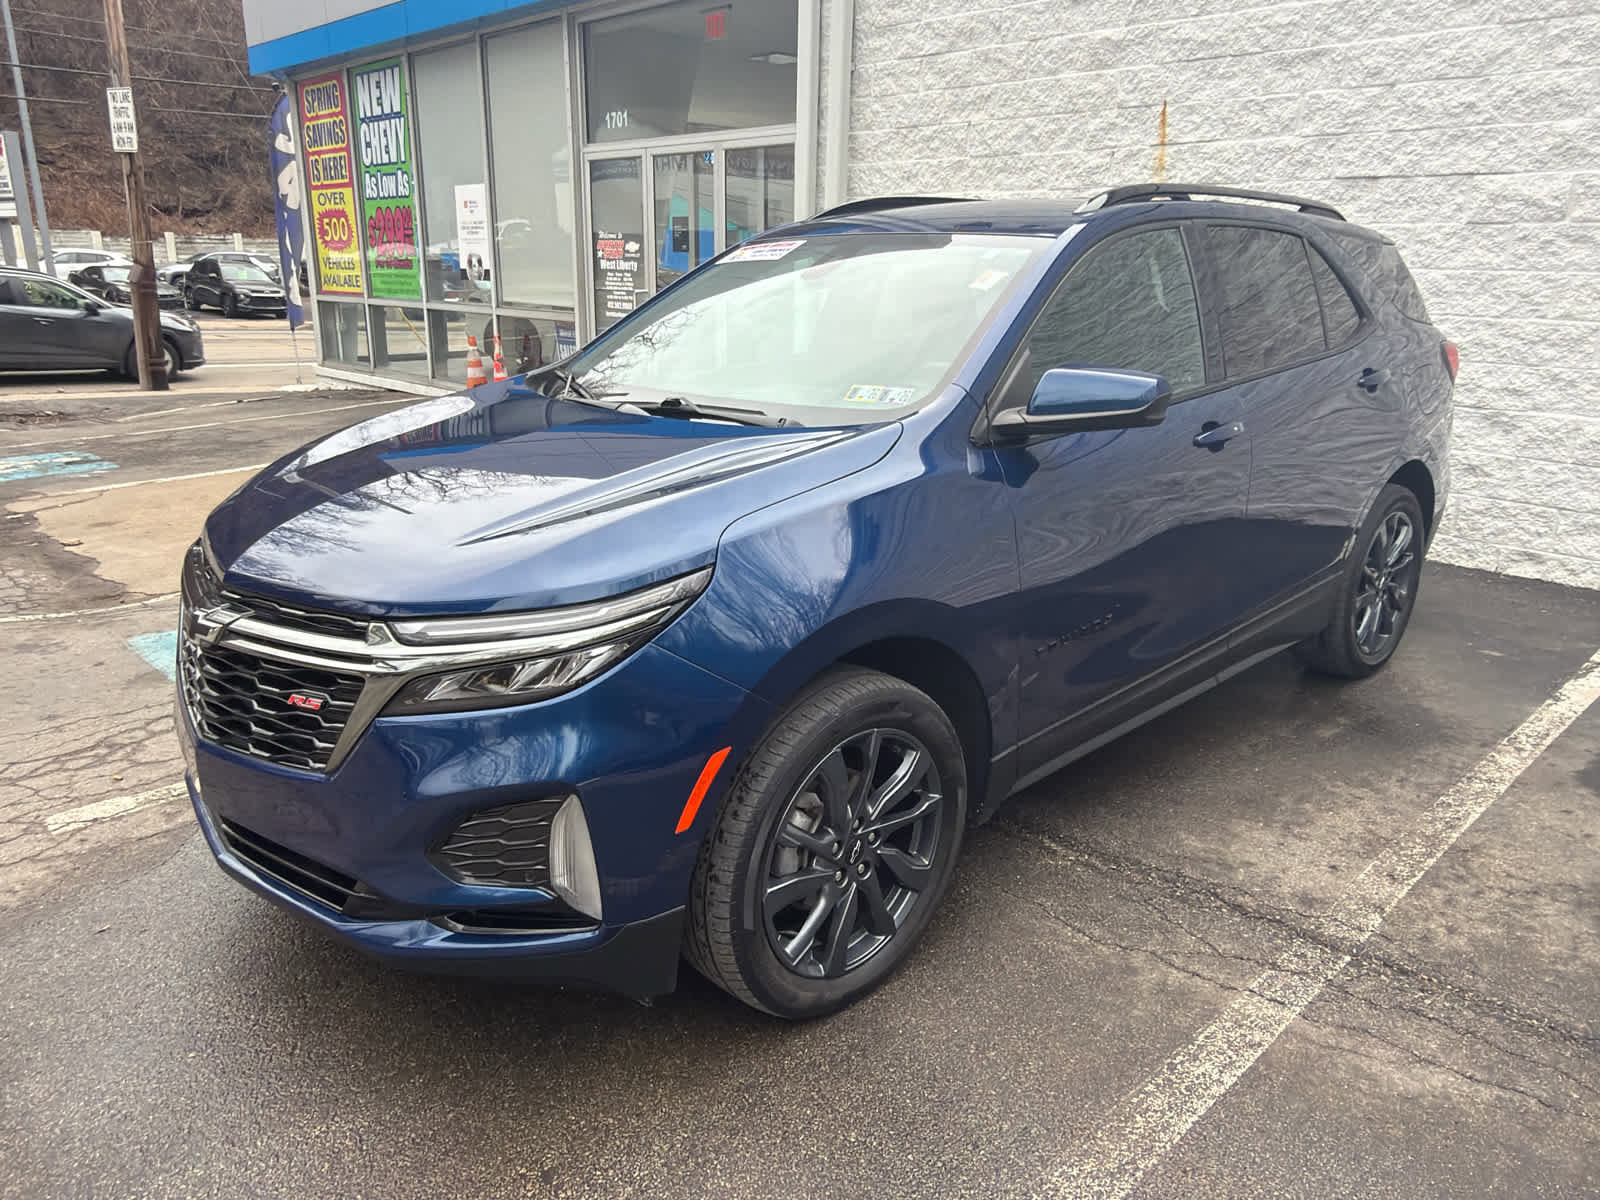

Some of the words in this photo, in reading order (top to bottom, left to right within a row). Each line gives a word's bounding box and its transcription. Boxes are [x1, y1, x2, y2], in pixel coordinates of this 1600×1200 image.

[305, 83, 339, 114] SPRING
[356, 66, 400, 118] NEW
[605, 110, 628, 128] 1701
[306, 118, 345, 149] SAVINGS
[360, 117, 406, 166] CHEVY
[311, 158, 320, 182] IS
[321, 154, 347, 181] HERE!
[318, 192, 345, 206] OVER
[324, 217, 348, 241] 500
[323, 257, 355, 270] VEHICLES
[600, 259, 615, 270] West
[616, 260, 637, 272] Liberty
[323, 273, 360, 288] AVAILABLE
[288, 694, 323, 710] RS
